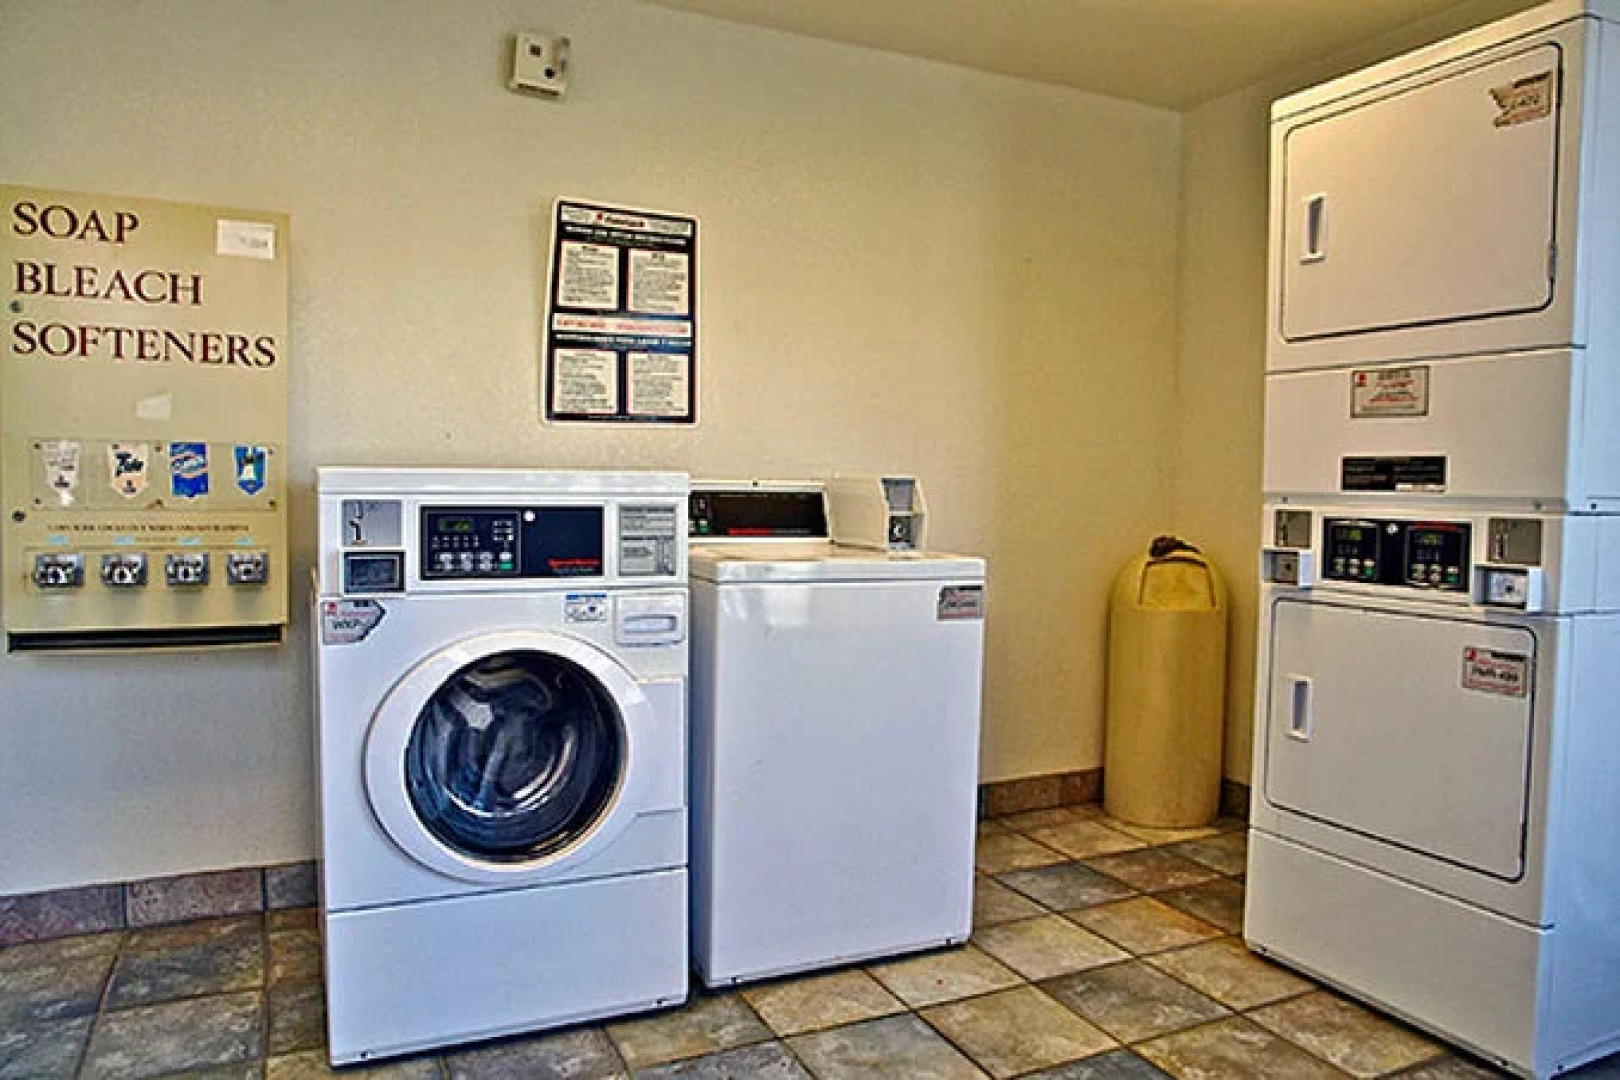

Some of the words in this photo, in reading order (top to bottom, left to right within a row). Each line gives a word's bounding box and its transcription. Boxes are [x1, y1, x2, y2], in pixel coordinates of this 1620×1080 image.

[13, 202, 139, 244] SOAP
[15, 260, 201, 306] BLEACH
[12, 321, 276, 367] SOFTENERS
